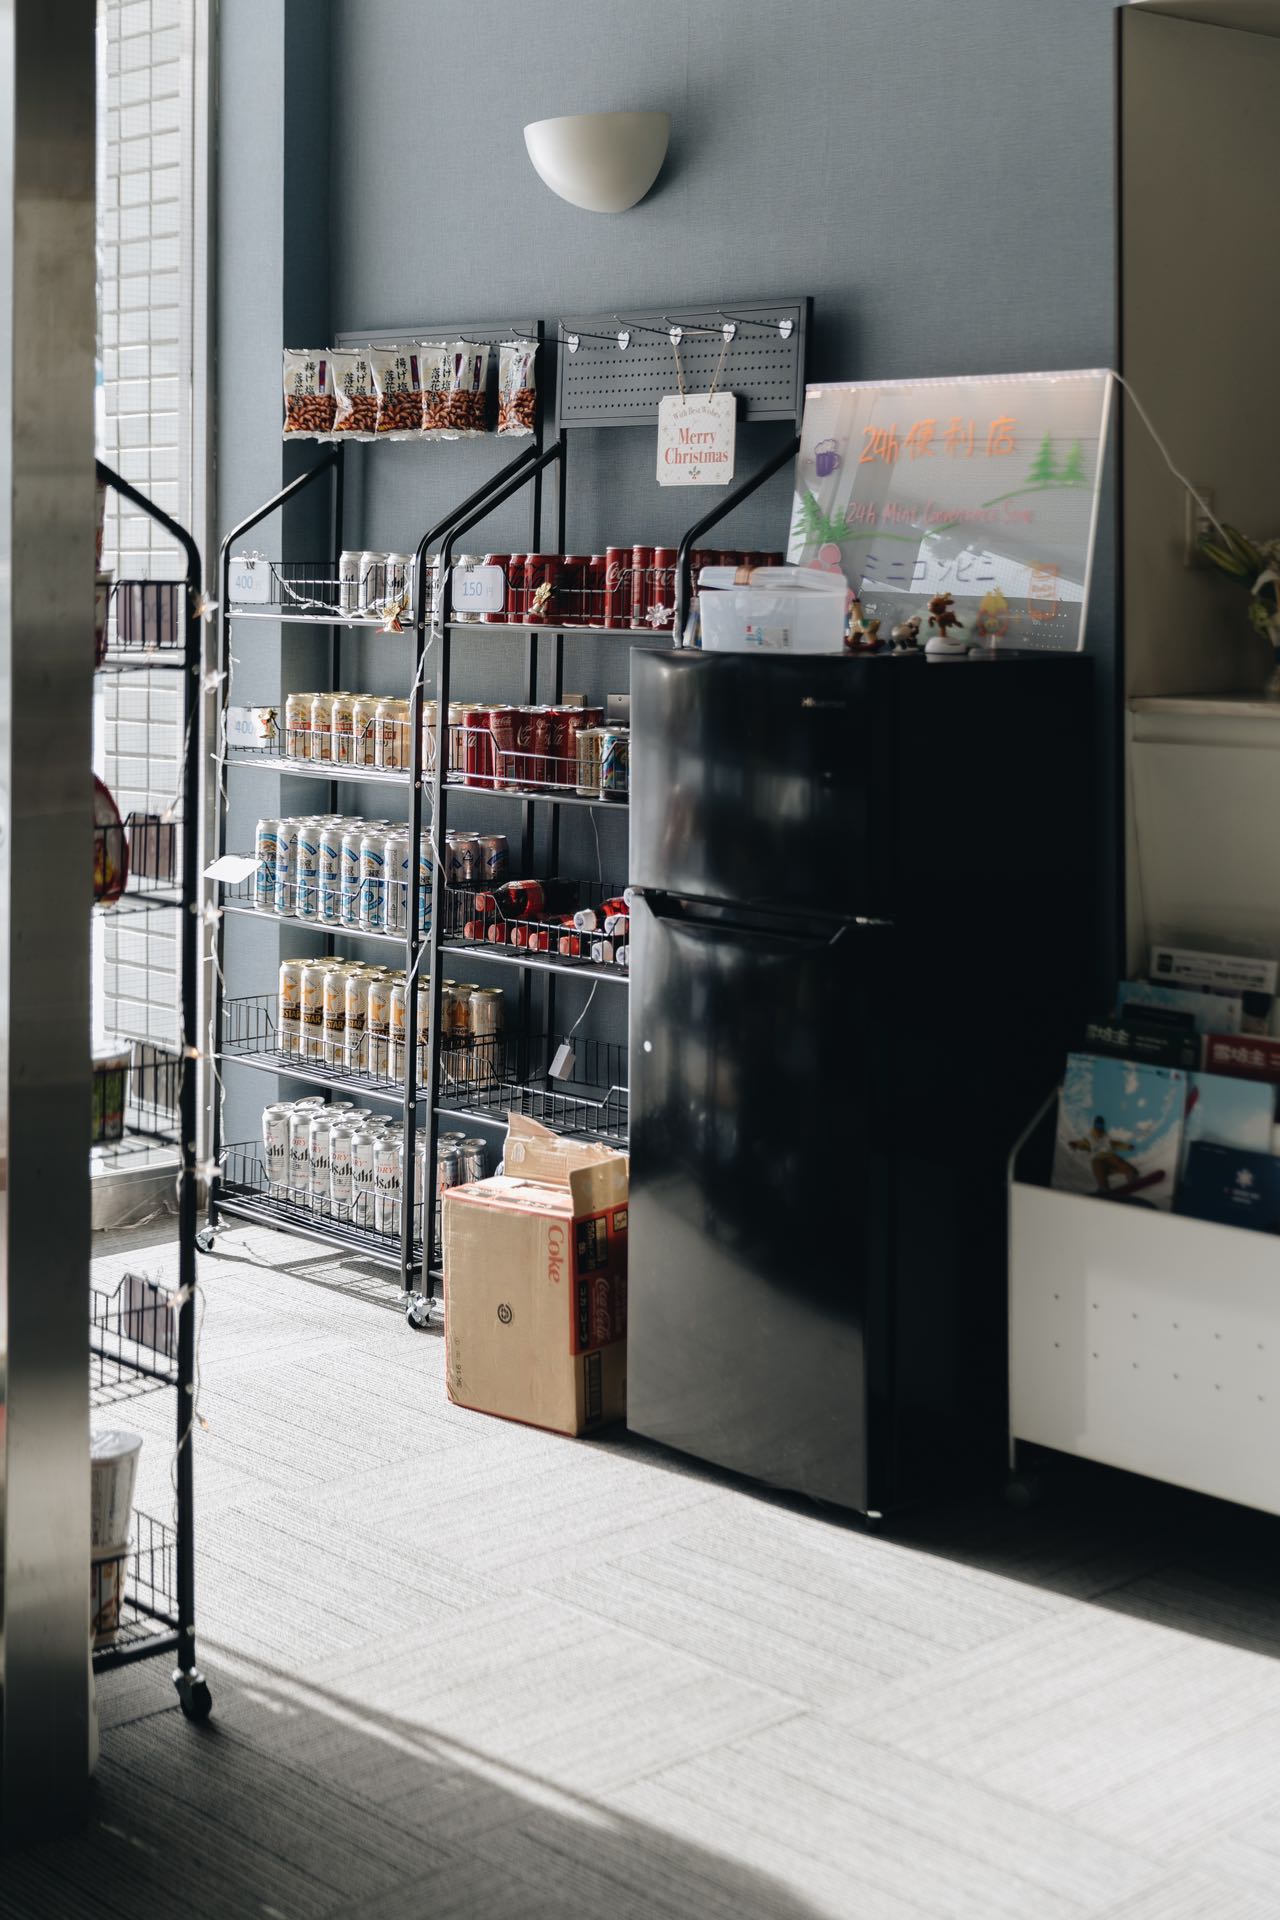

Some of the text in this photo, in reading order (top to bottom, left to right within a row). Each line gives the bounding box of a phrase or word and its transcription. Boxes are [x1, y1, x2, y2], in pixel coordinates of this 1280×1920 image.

[679, 427, 717, 445] Merry
[664, 447, 729, 465] Christmas
[547, 1224, 565, 1284] Coke
